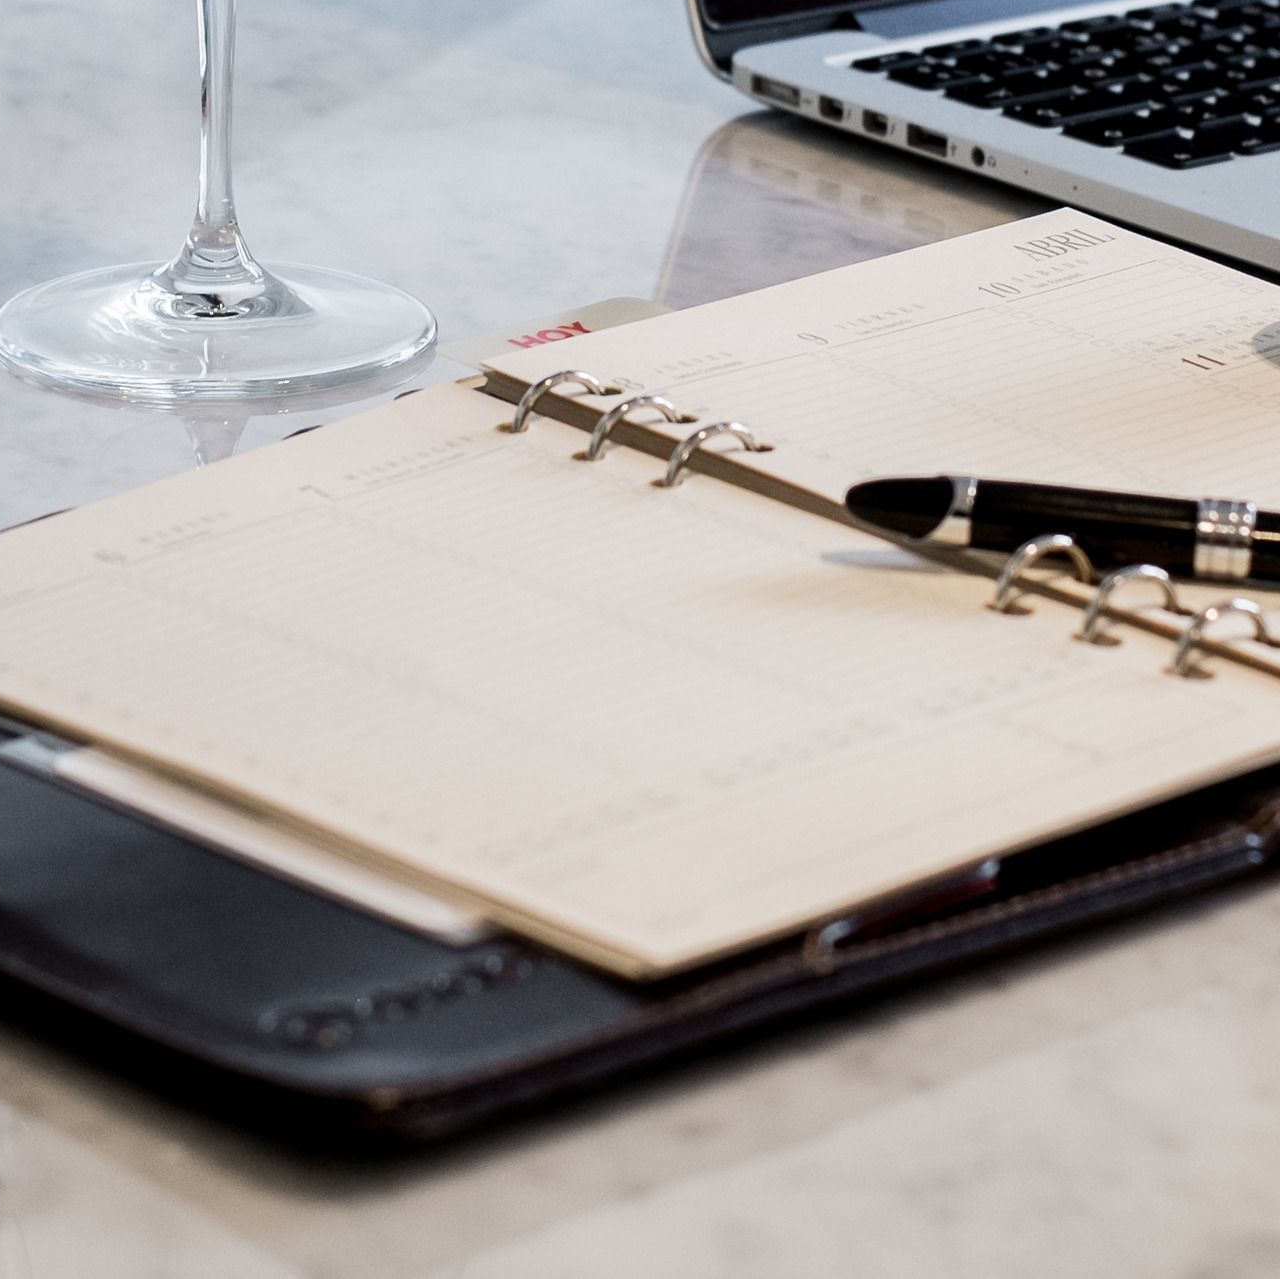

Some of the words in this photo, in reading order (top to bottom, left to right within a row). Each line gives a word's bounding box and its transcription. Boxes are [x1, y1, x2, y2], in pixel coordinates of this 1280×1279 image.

[1013, 227, 1117, 262] ABRIL
[978, 281, 1022, 299] 10
[507, 320, 593, 349] HOY
[797, 332, 829, 346] 9
[1179, 352, 1227, 371] 11
